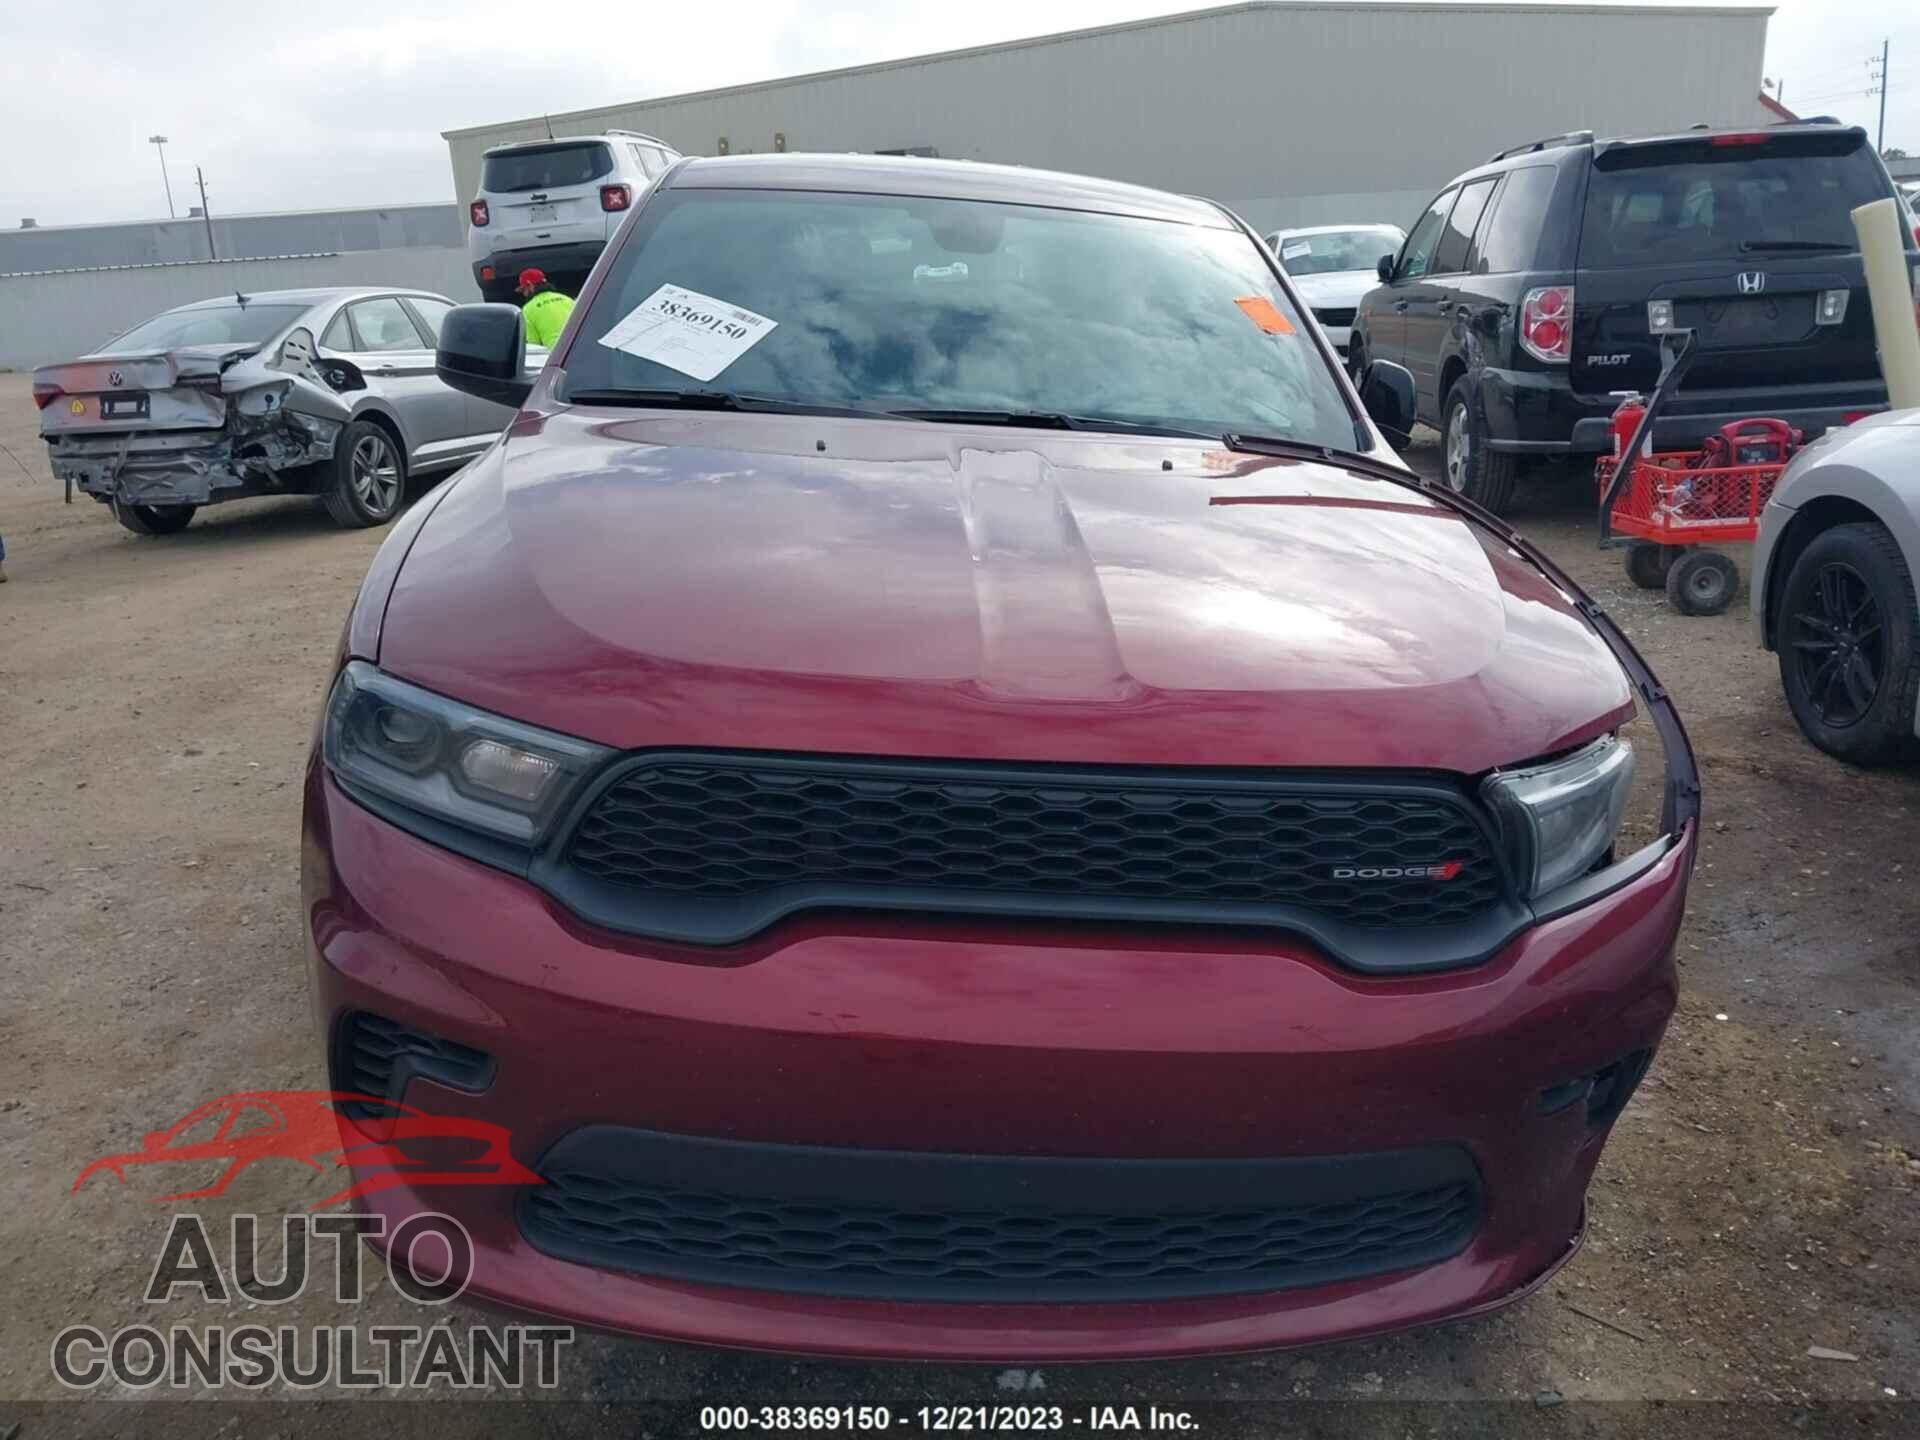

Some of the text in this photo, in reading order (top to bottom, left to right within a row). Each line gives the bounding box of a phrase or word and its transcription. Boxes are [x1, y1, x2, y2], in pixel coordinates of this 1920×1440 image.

[651, 299, 747, 340] 38369150
[1587, 353, 1631, 366] PILOT
[1333, 866, 1450, 878] DODGE
